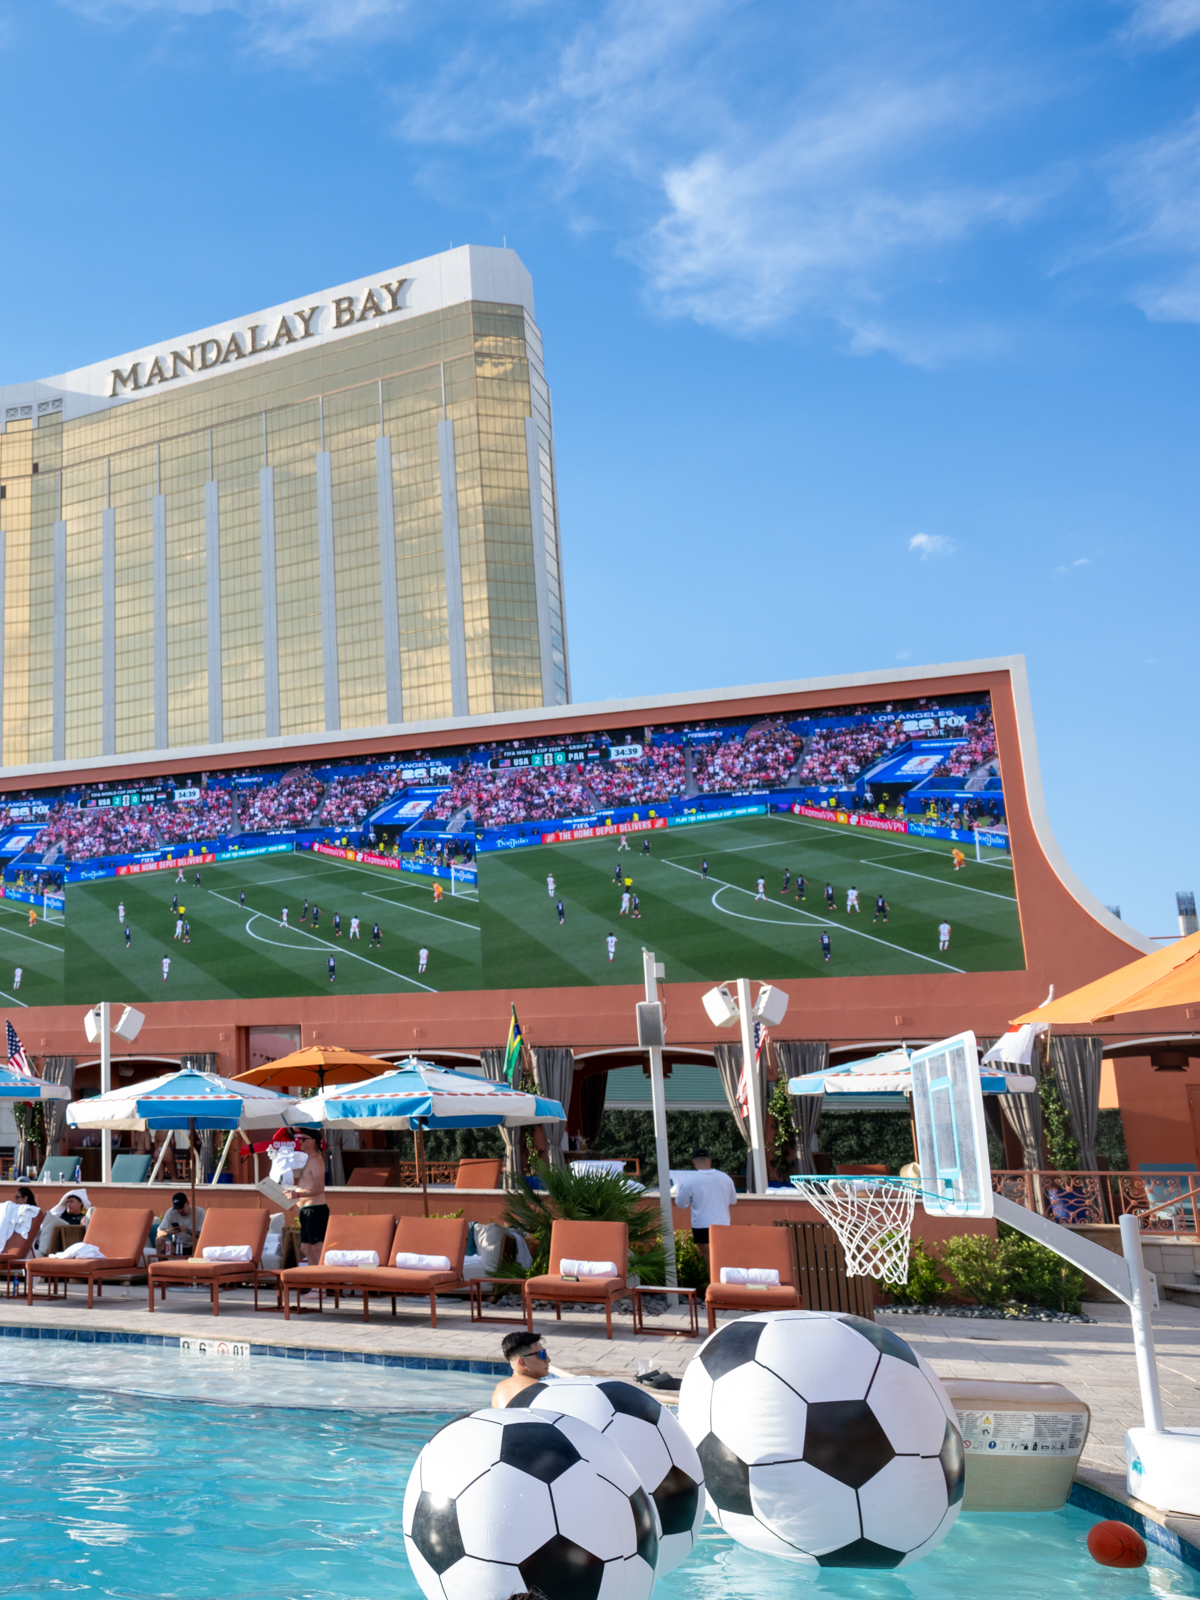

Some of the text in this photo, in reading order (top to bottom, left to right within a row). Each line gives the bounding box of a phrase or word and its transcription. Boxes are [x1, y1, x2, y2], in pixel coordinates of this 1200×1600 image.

[109, 278, 408, 398] MANDALAY BAY
[898, 710, 953, 720] ANGELES
[939, 715, 967, 728] FOX
[927, 729, 945, 737] LIVE
[615, 748, 638, 756] 34:39
[514, 758, 529, 766] USA
[569, 753, 584, 761] PAR
[430, 766, 452, 776] FOX
[32, 805, 49, 814] FOX
[801, 809, 836, 821] ExpressVPN
[860, 815, 904, 832] ExpressVPN
[559, 822, 651, 840] THE HOME DEPOT DELIVERS
[319, 846, 346, 857] ExpressVPN
[130, 856, 202, 872] THE HOME DEPOT DELIVERS
[364, 852, 398, 868] ExpressVPN
[273, 1141, 296, 1149] GUARD
